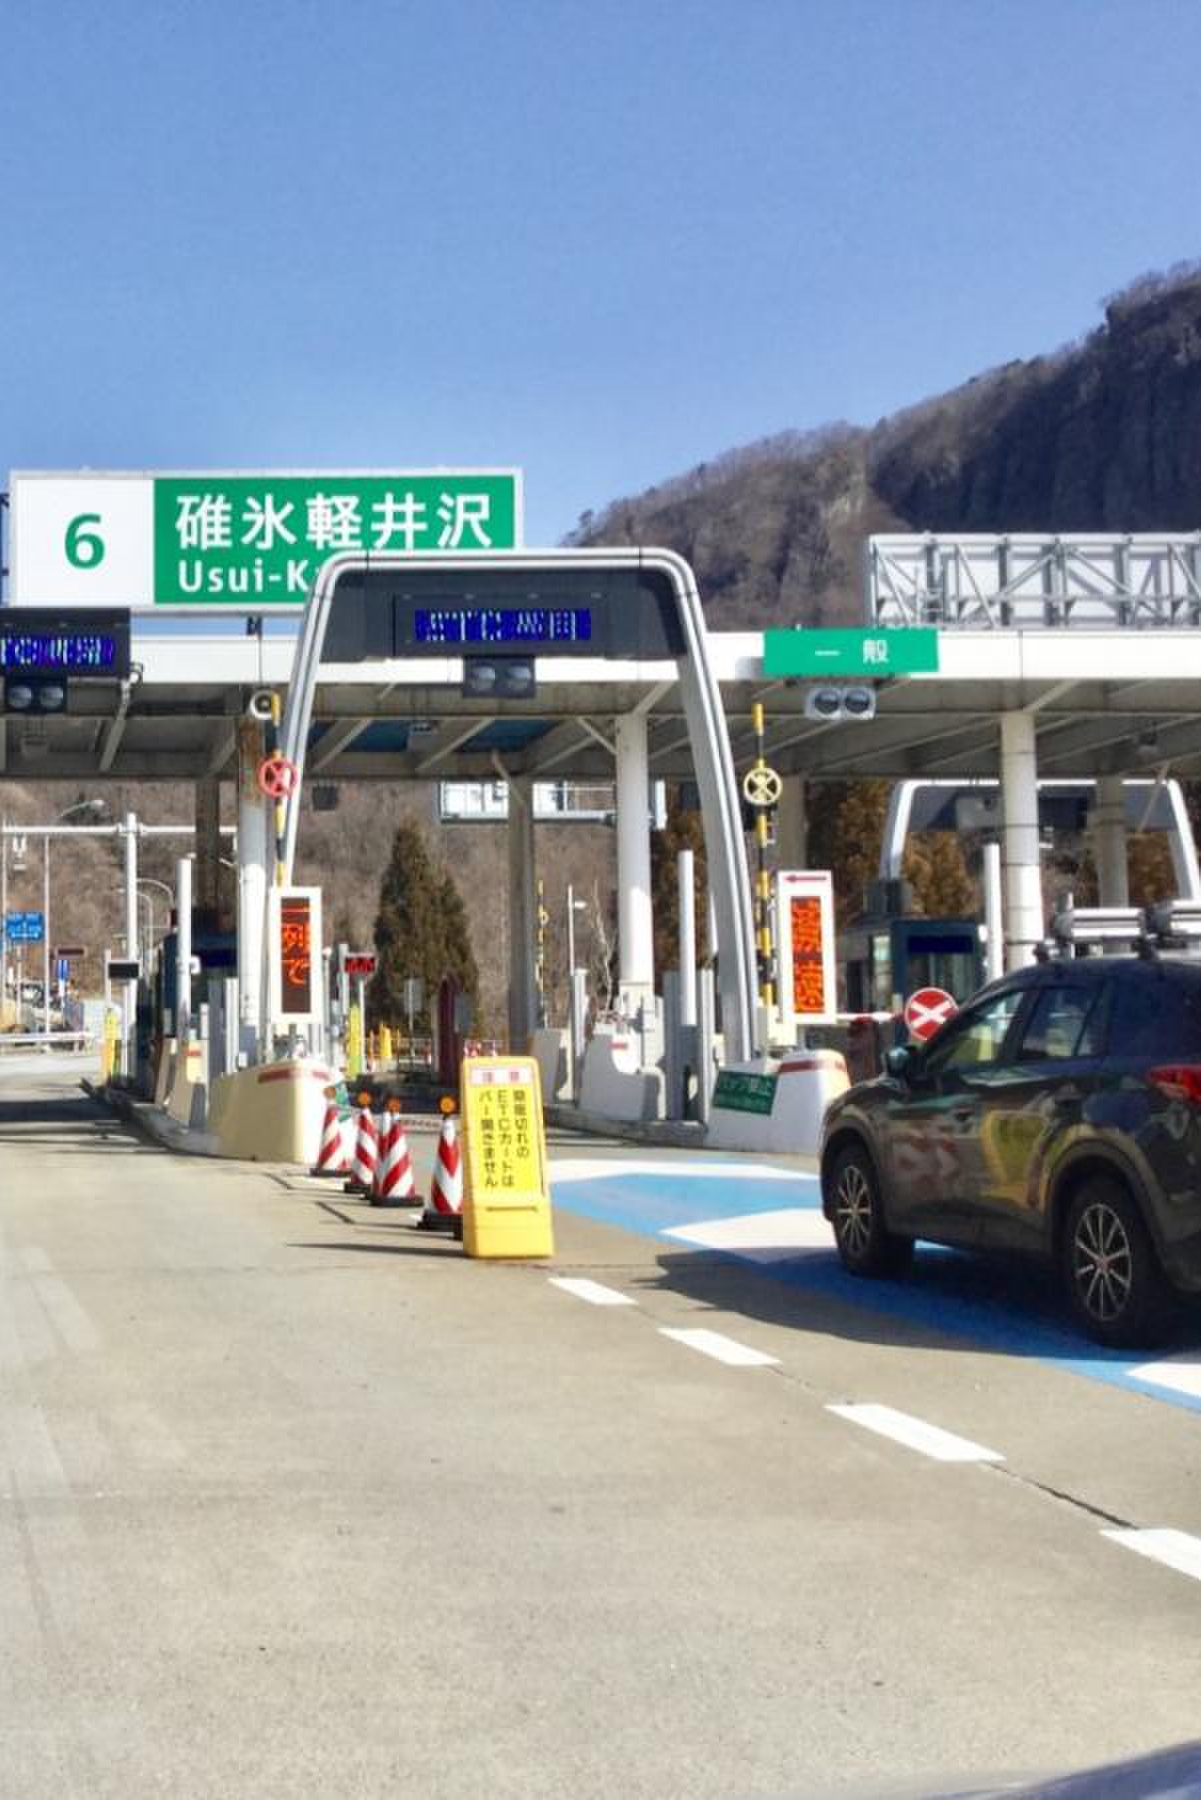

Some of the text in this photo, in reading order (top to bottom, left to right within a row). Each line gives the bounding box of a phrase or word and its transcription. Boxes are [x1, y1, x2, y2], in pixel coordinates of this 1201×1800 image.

[64, 513, 106, 569] 6
[175, 492, 493, 549] 碓氷軽井沢
[178, 557, 320, 593] Usui-K
[814, 639, 889, 664] 一般
